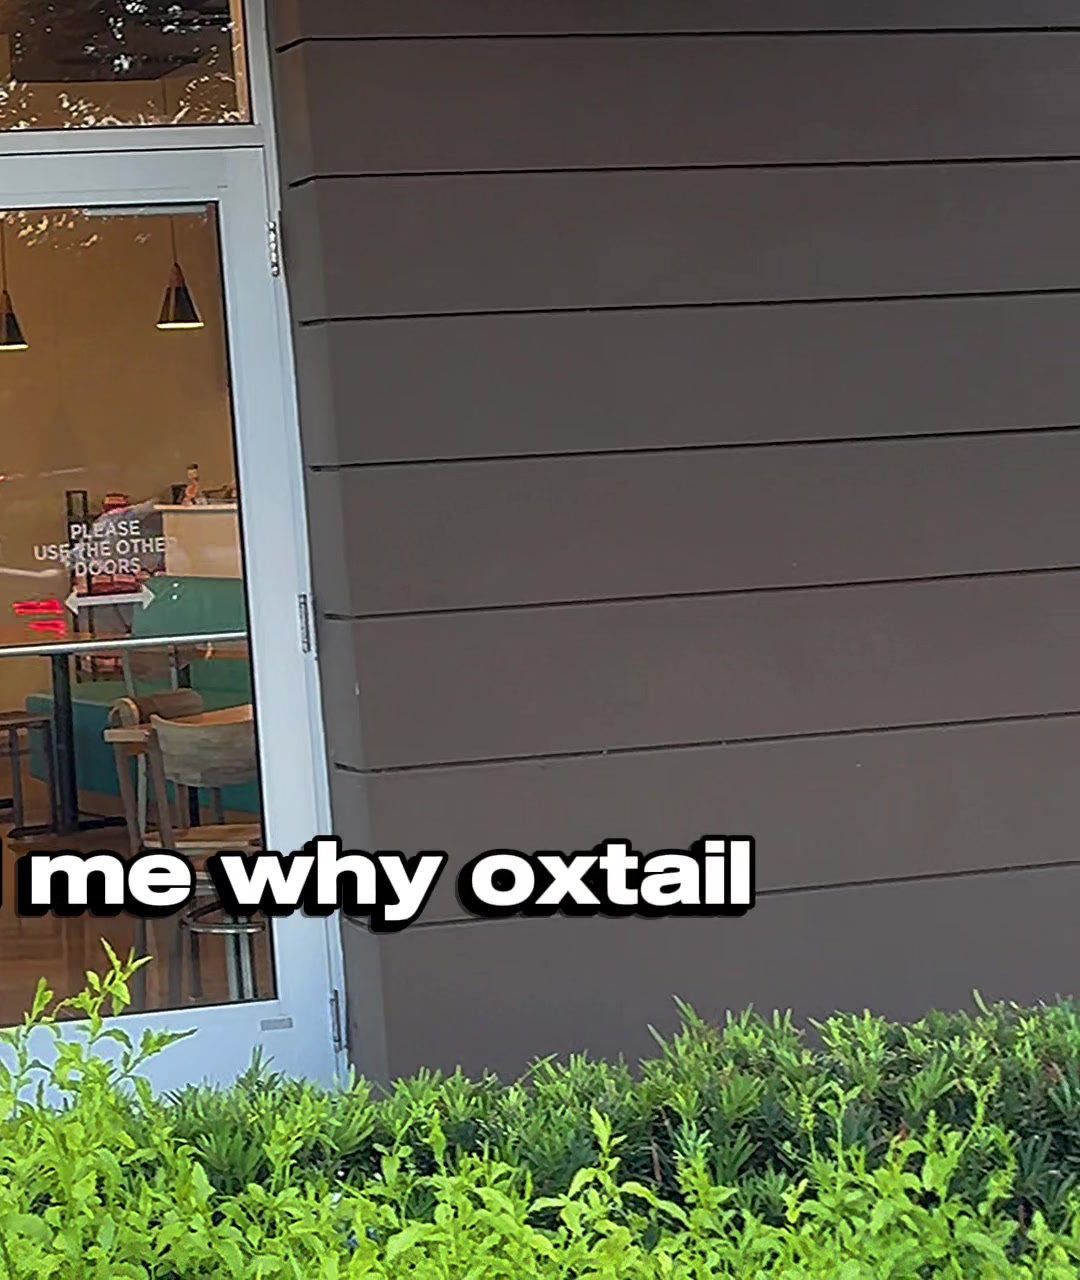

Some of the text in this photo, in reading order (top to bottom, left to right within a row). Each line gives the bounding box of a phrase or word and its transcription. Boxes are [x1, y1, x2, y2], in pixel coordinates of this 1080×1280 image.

[70, 520, 141, 540] PLEASE
[33, 544, 71, 563] USE
[75, 557, 142, 577] DOORS
